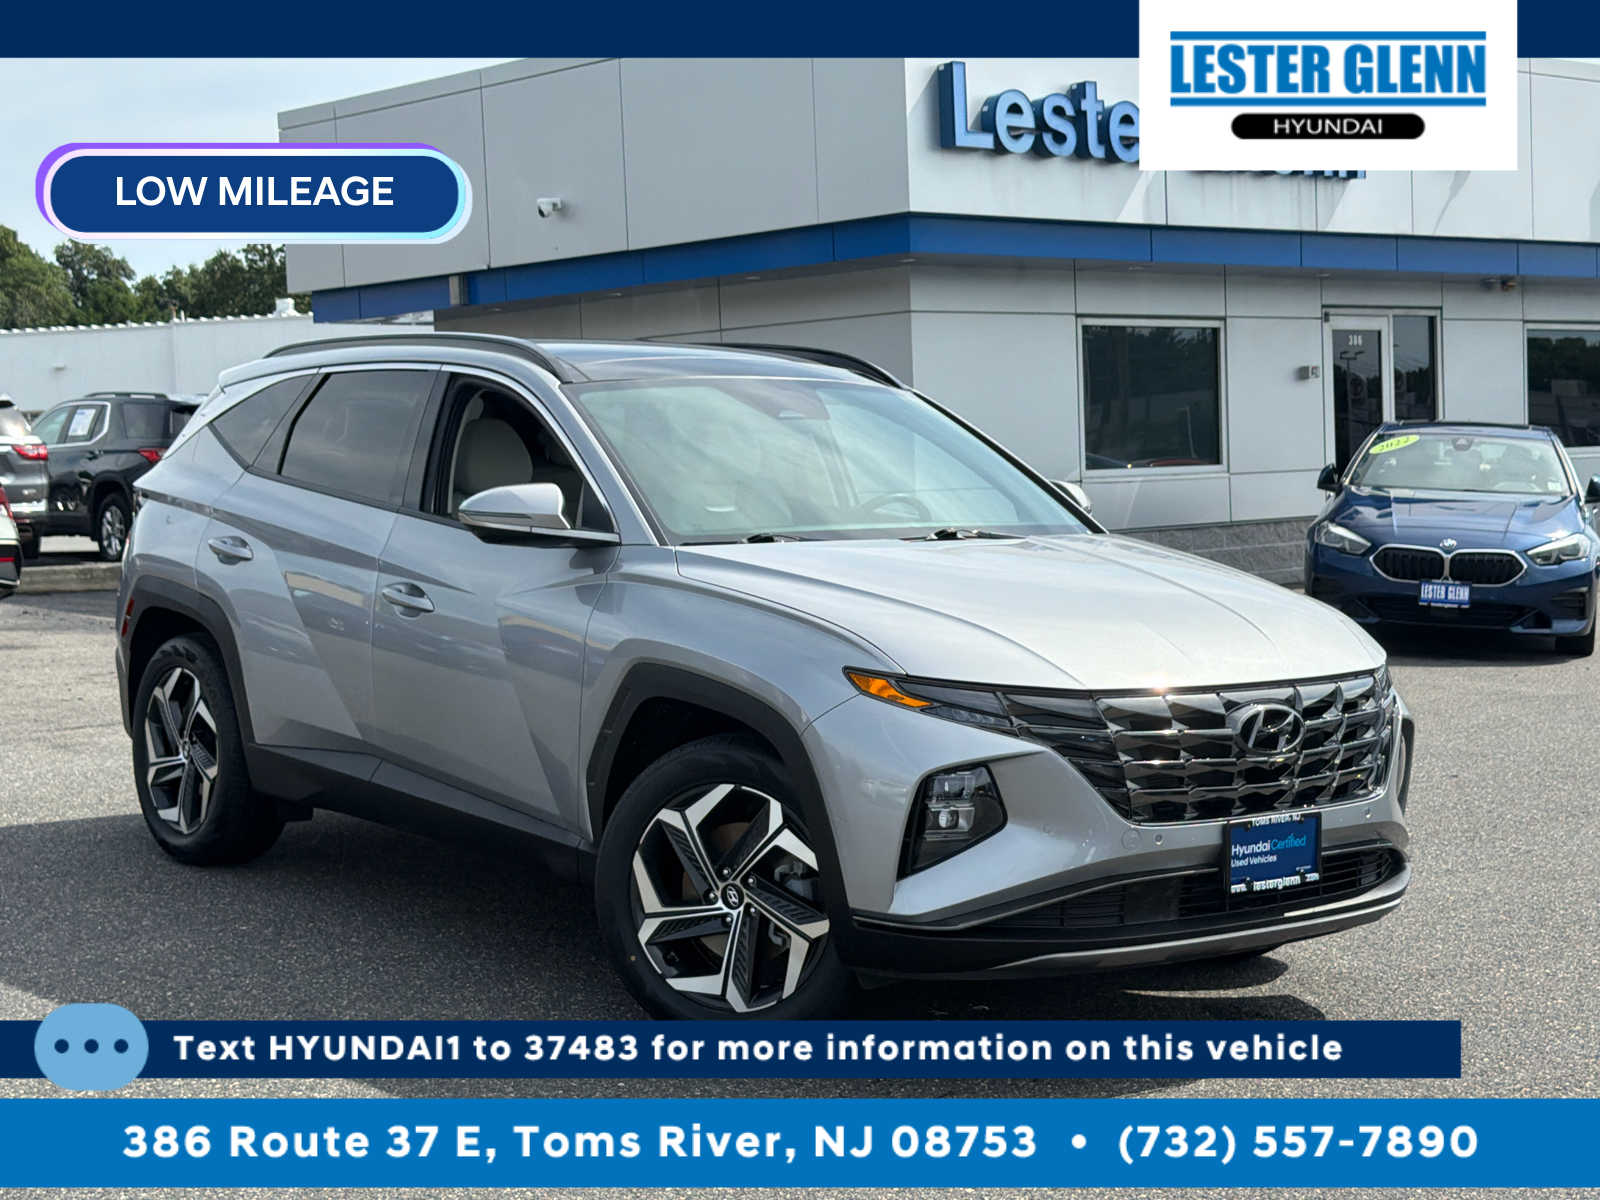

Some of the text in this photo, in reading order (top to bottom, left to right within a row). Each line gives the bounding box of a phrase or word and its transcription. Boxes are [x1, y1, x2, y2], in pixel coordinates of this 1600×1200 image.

[938, 60, 1139, 163] Leste
[1231, 854, 1277, 867] Used Vehicles
